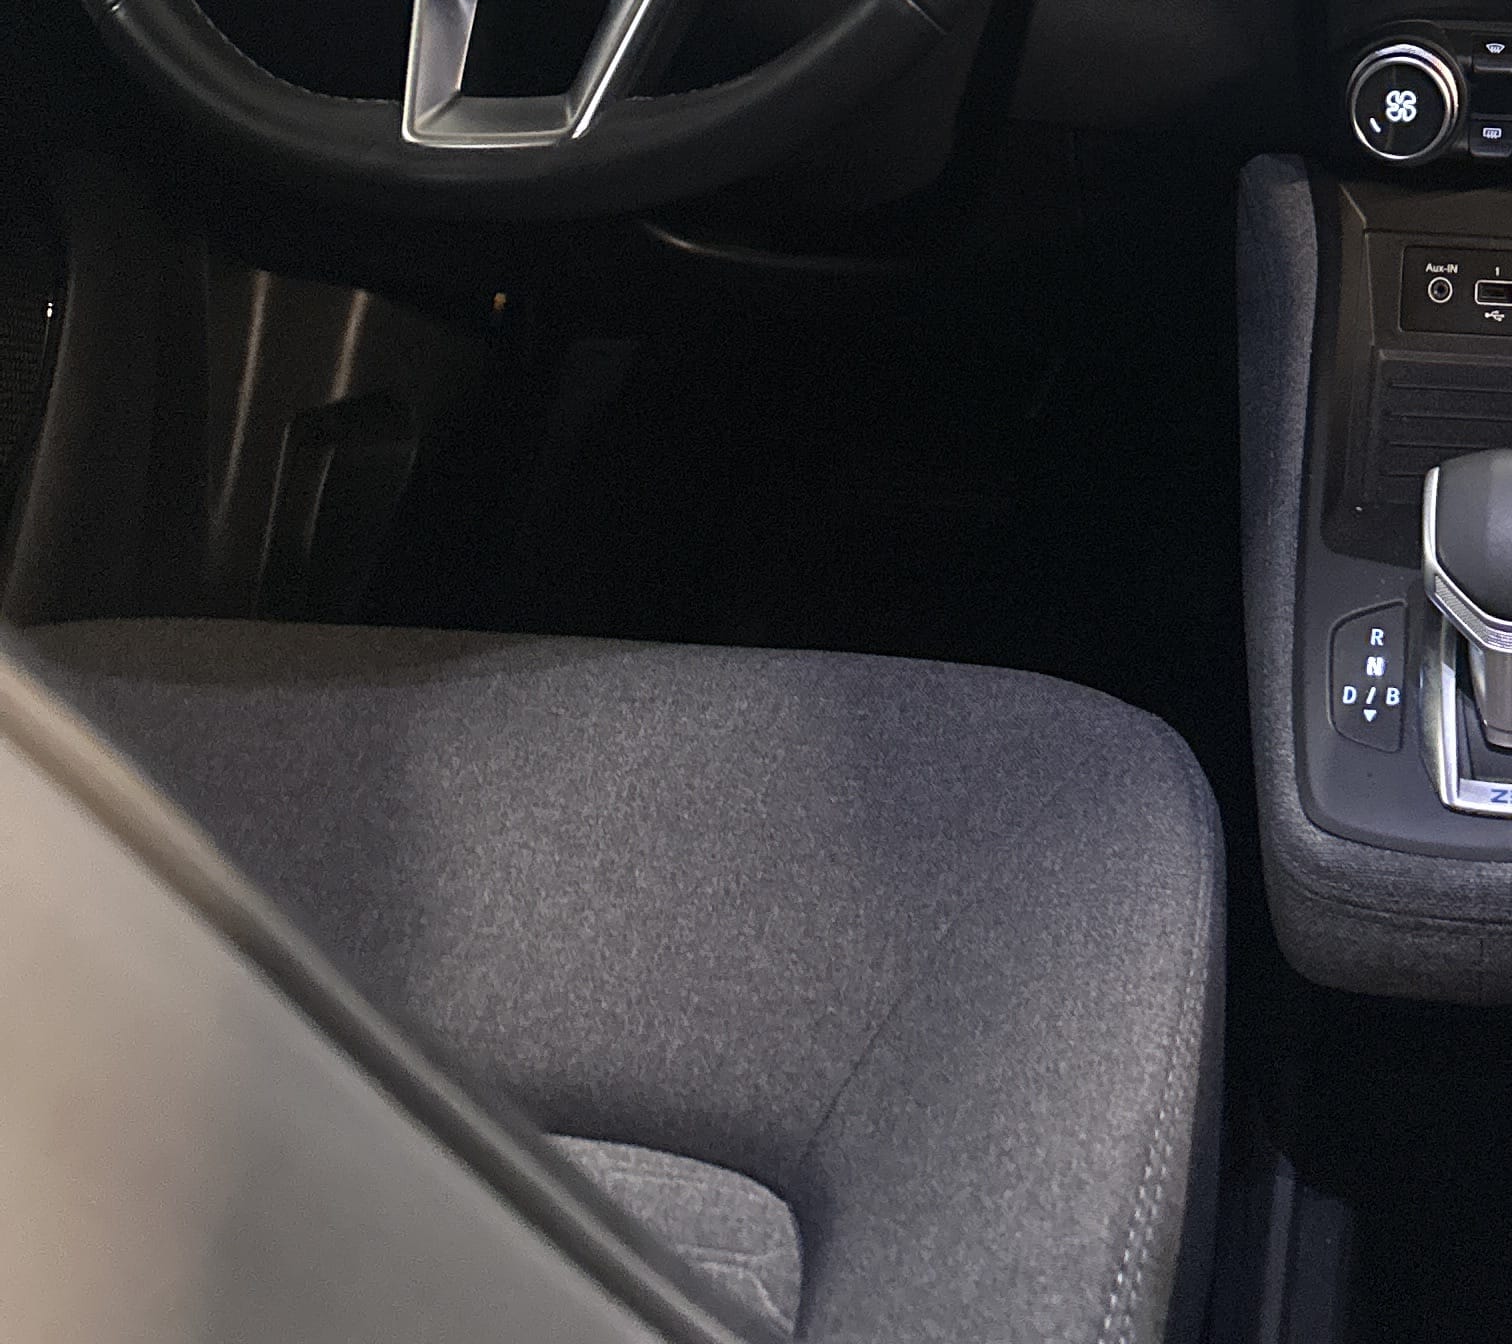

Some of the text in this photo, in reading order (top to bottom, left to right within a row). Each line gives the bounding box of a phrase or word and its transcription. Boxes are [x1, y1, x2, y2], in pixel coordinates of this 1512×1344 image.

[1425, 263, 1459, 274] Aux-IN
[1495, 266, 1500, 277] 1
[1370, 628, 1384, 646] R
[1366, 656, 1385, 676] N
